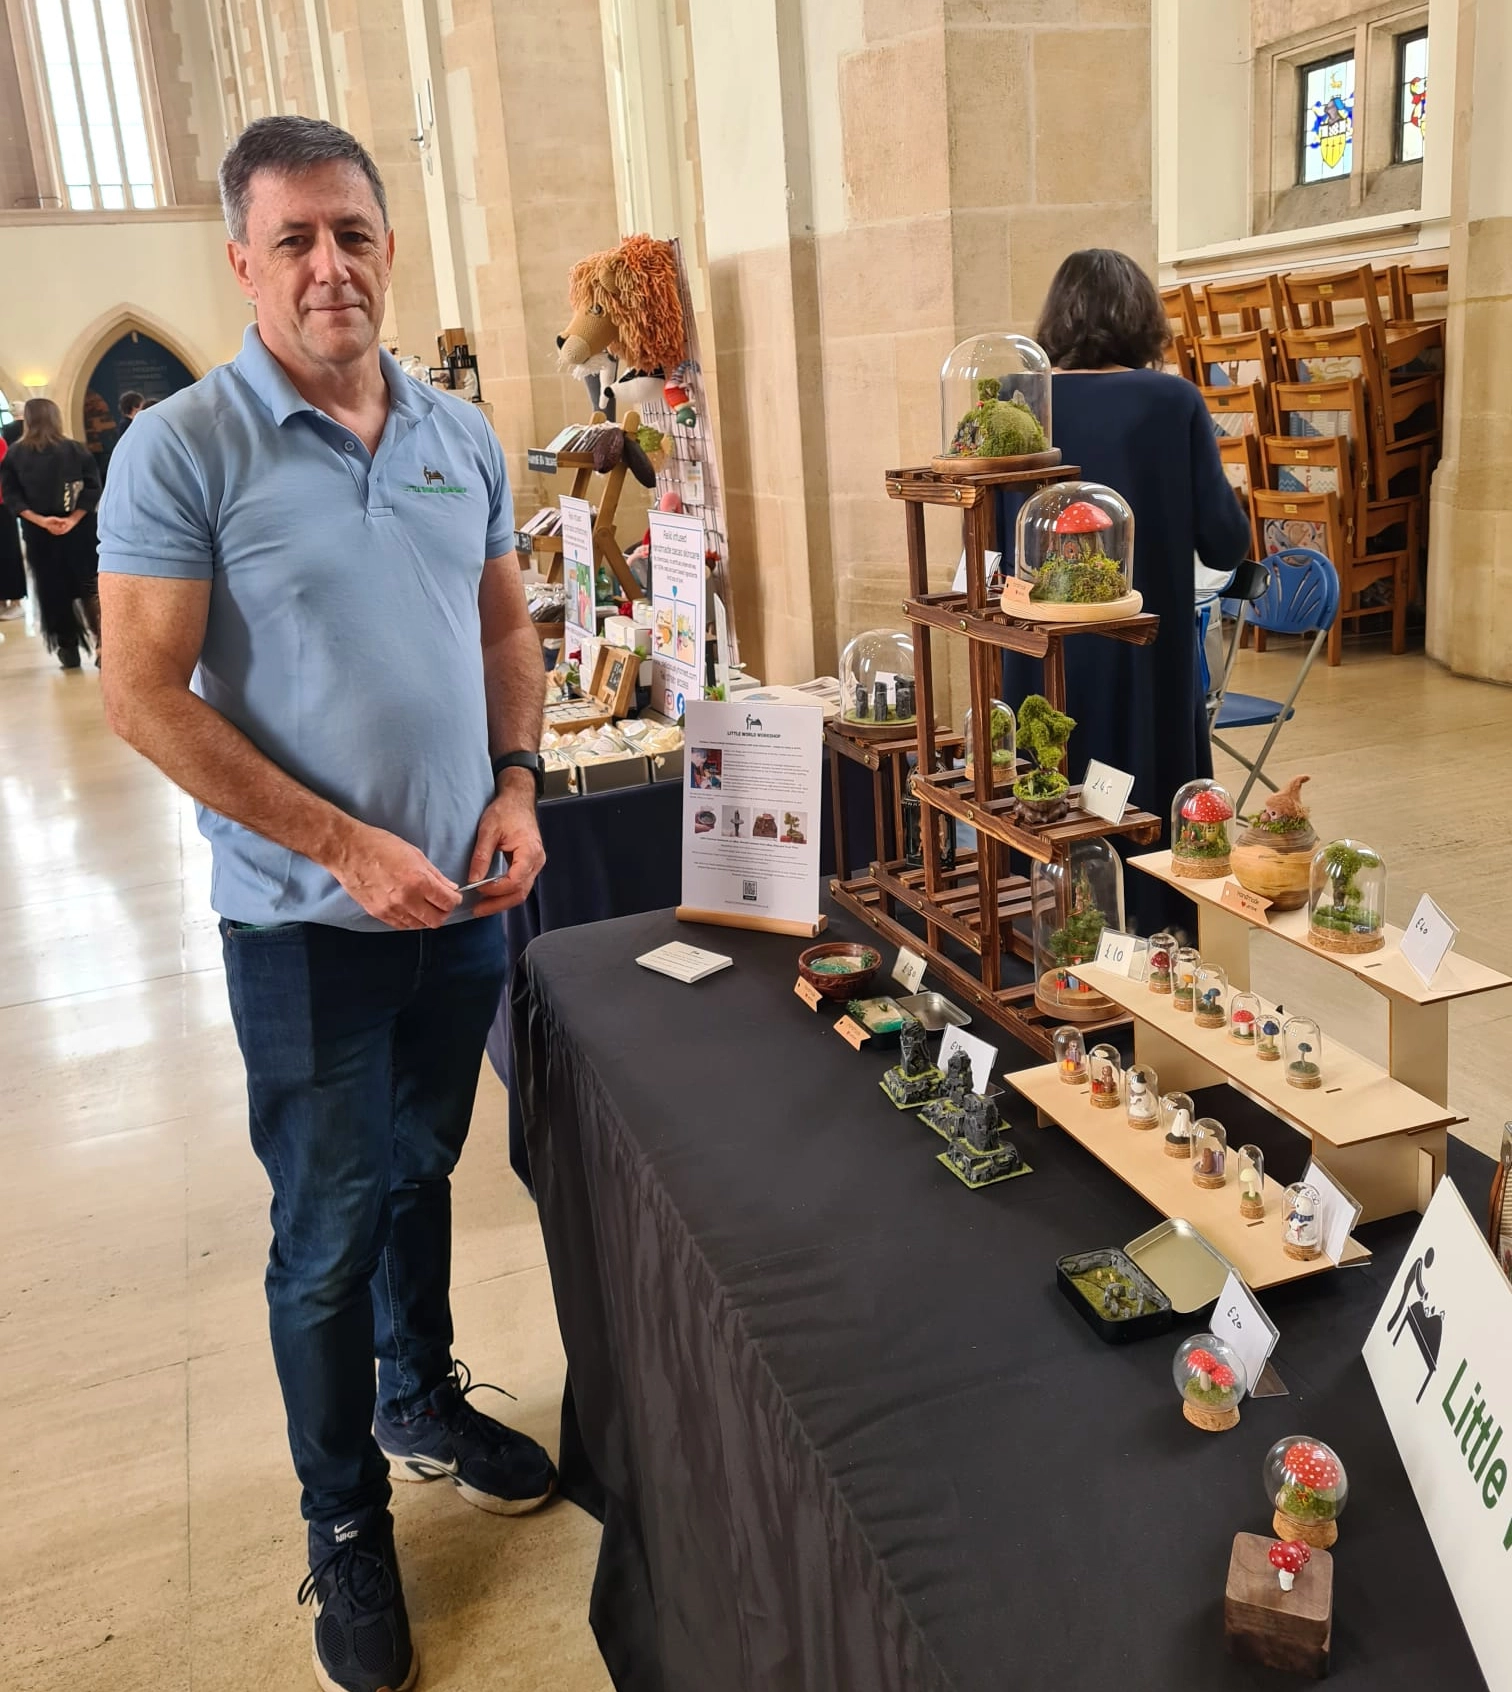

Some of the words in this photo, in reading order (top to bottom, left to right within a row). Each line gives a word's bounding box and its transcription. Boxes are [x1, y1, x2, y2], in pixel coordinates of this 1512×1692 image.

[1104, 942, 1124, 962] £10
[1227, 1305, 1242, 1330] £20
[1442, 1357, 1508, 1510] Little
[336, 1530, 359, 1542] NIKE
